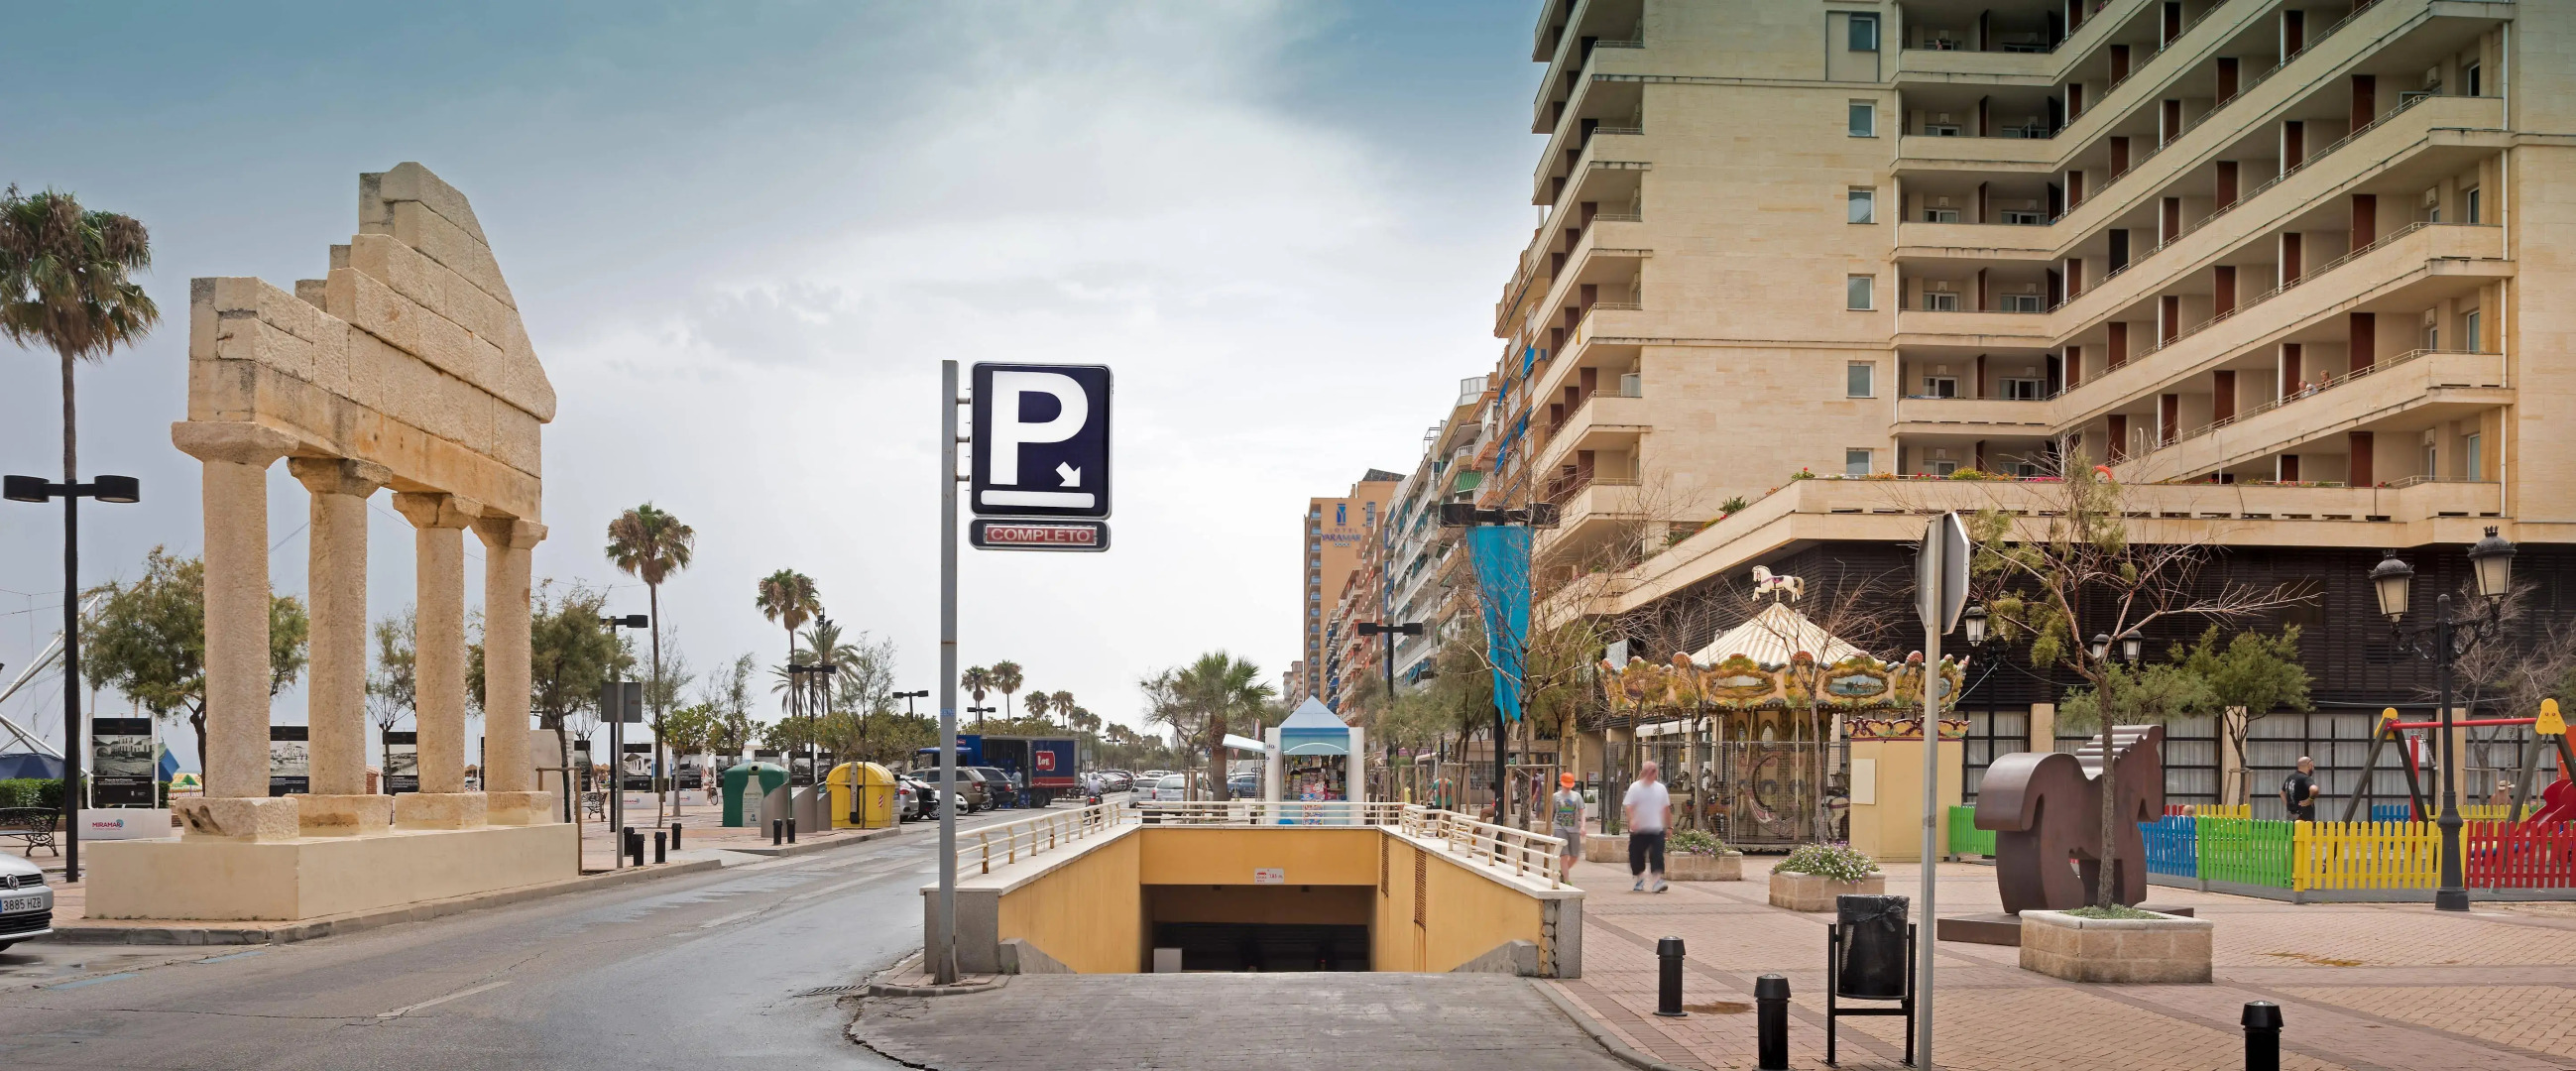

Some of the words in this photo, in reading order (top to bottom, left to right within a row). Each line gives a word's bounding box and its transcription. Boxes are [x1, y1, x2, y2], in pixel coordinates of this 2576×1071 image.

[990, 370, 1089, 486] P
[991, 529, 1091, 542] COMPLETO
[3, 898, 26, 911] 3885
[27, 896, 42, 909] HZB
